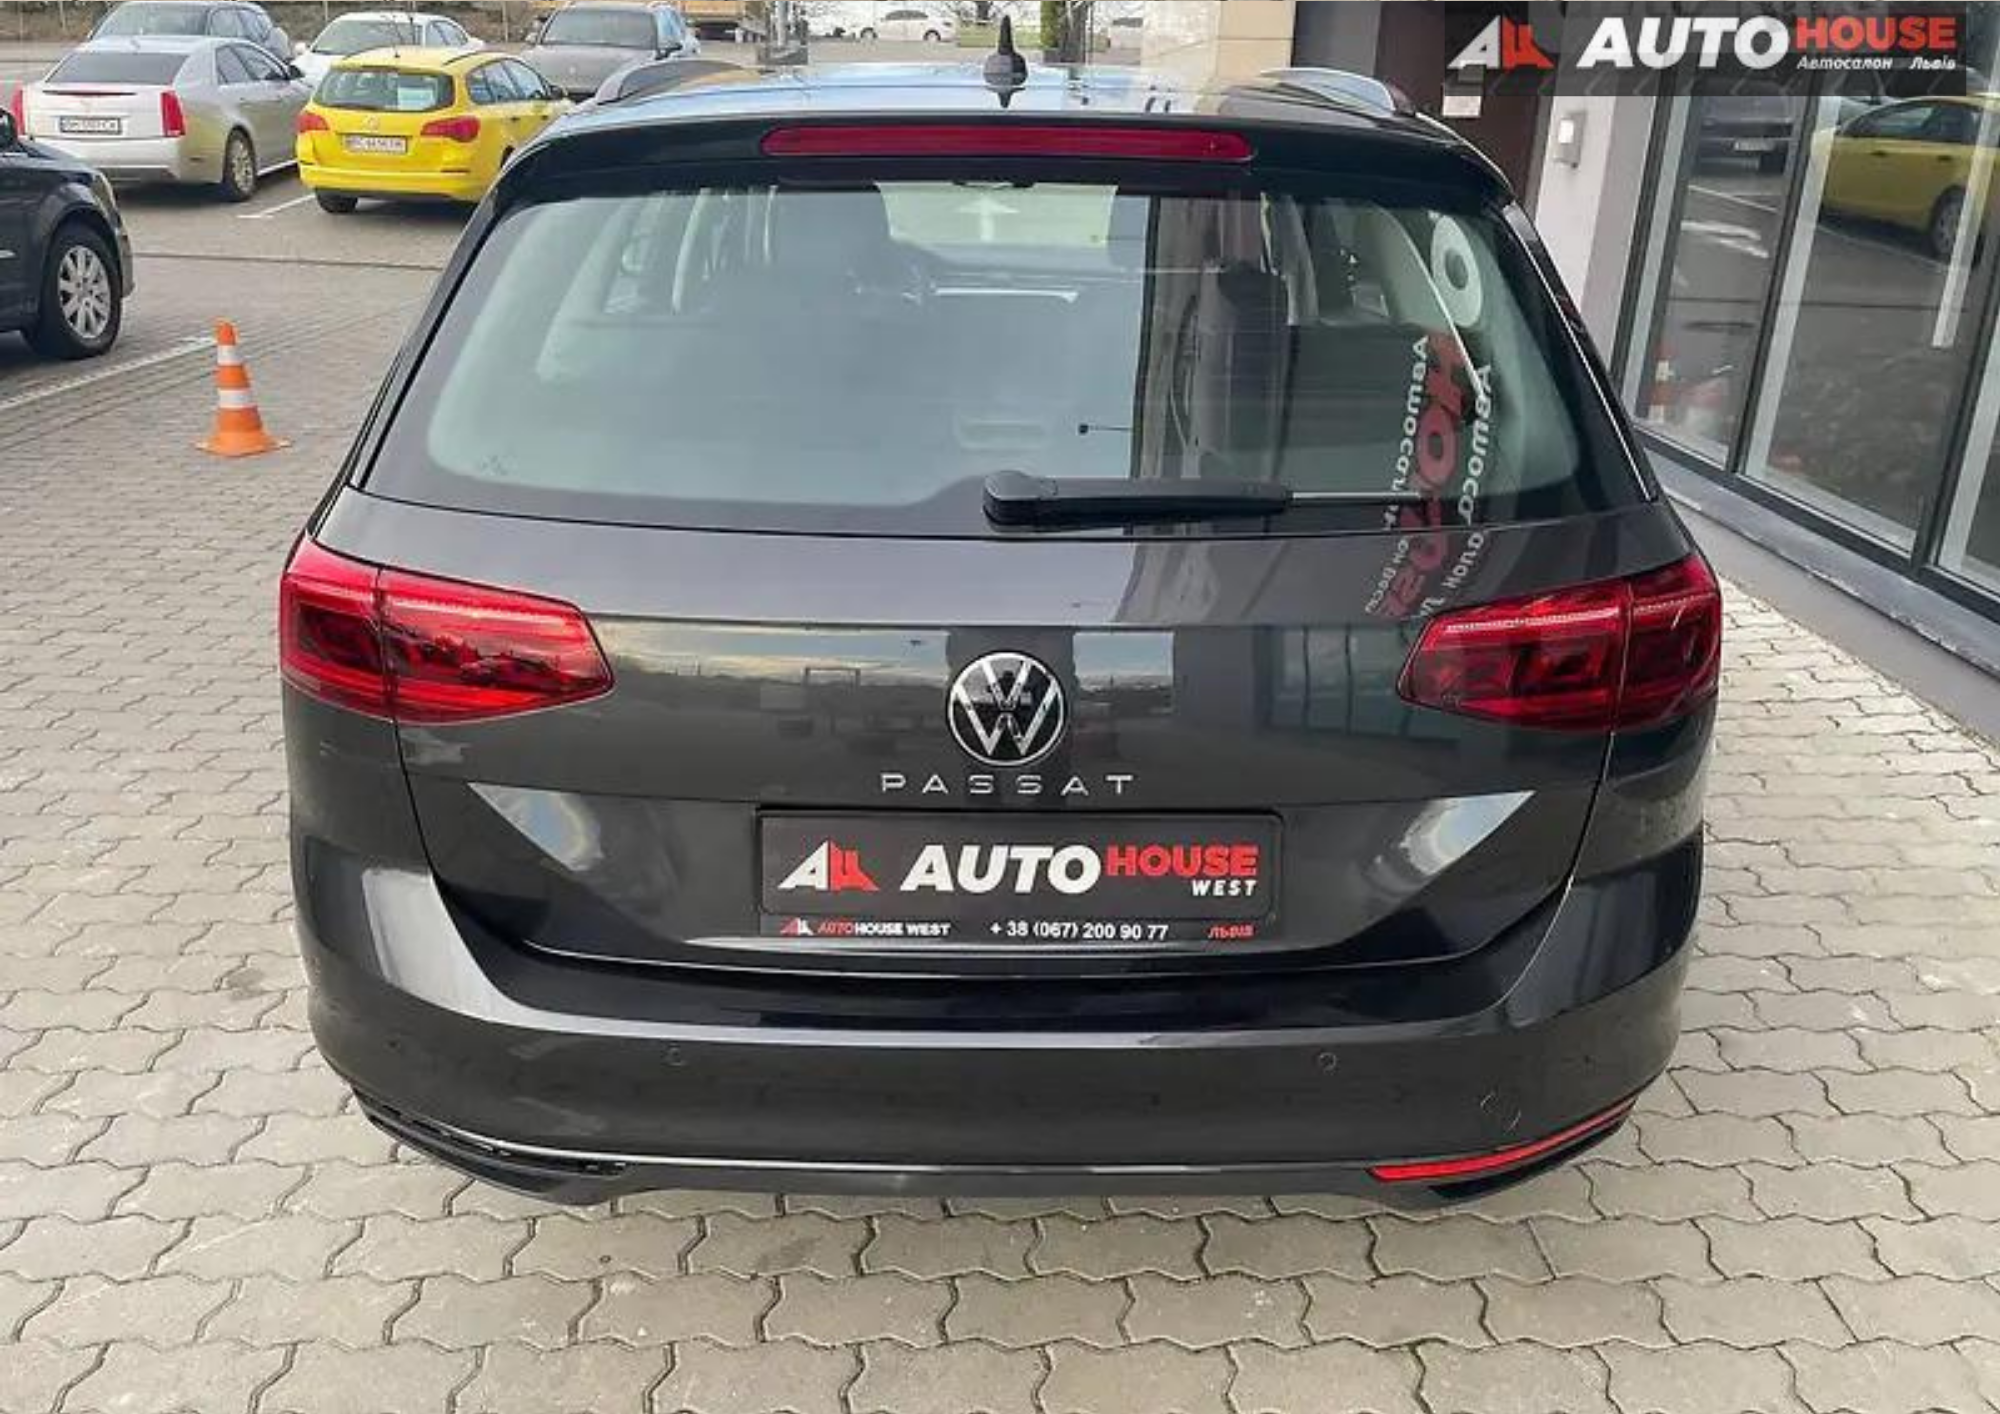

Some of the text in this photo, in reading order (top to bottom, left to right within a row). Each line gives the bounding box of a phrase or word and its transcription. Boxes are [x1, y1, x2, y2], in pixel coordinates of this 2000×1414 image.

[880, 773, 1134, 795] PASSAT
[1192, 880, 1257, 897] WEST
[906, 922, 951, 937] WEST
[1006, 920, 1029, 937] 38
[1032, 921, 1078, 939] (067)
[1082, 922, 1116, 940] 200
[1120, 924, 1142, 940] 90
[1147, 924, 1169, 941] 77
